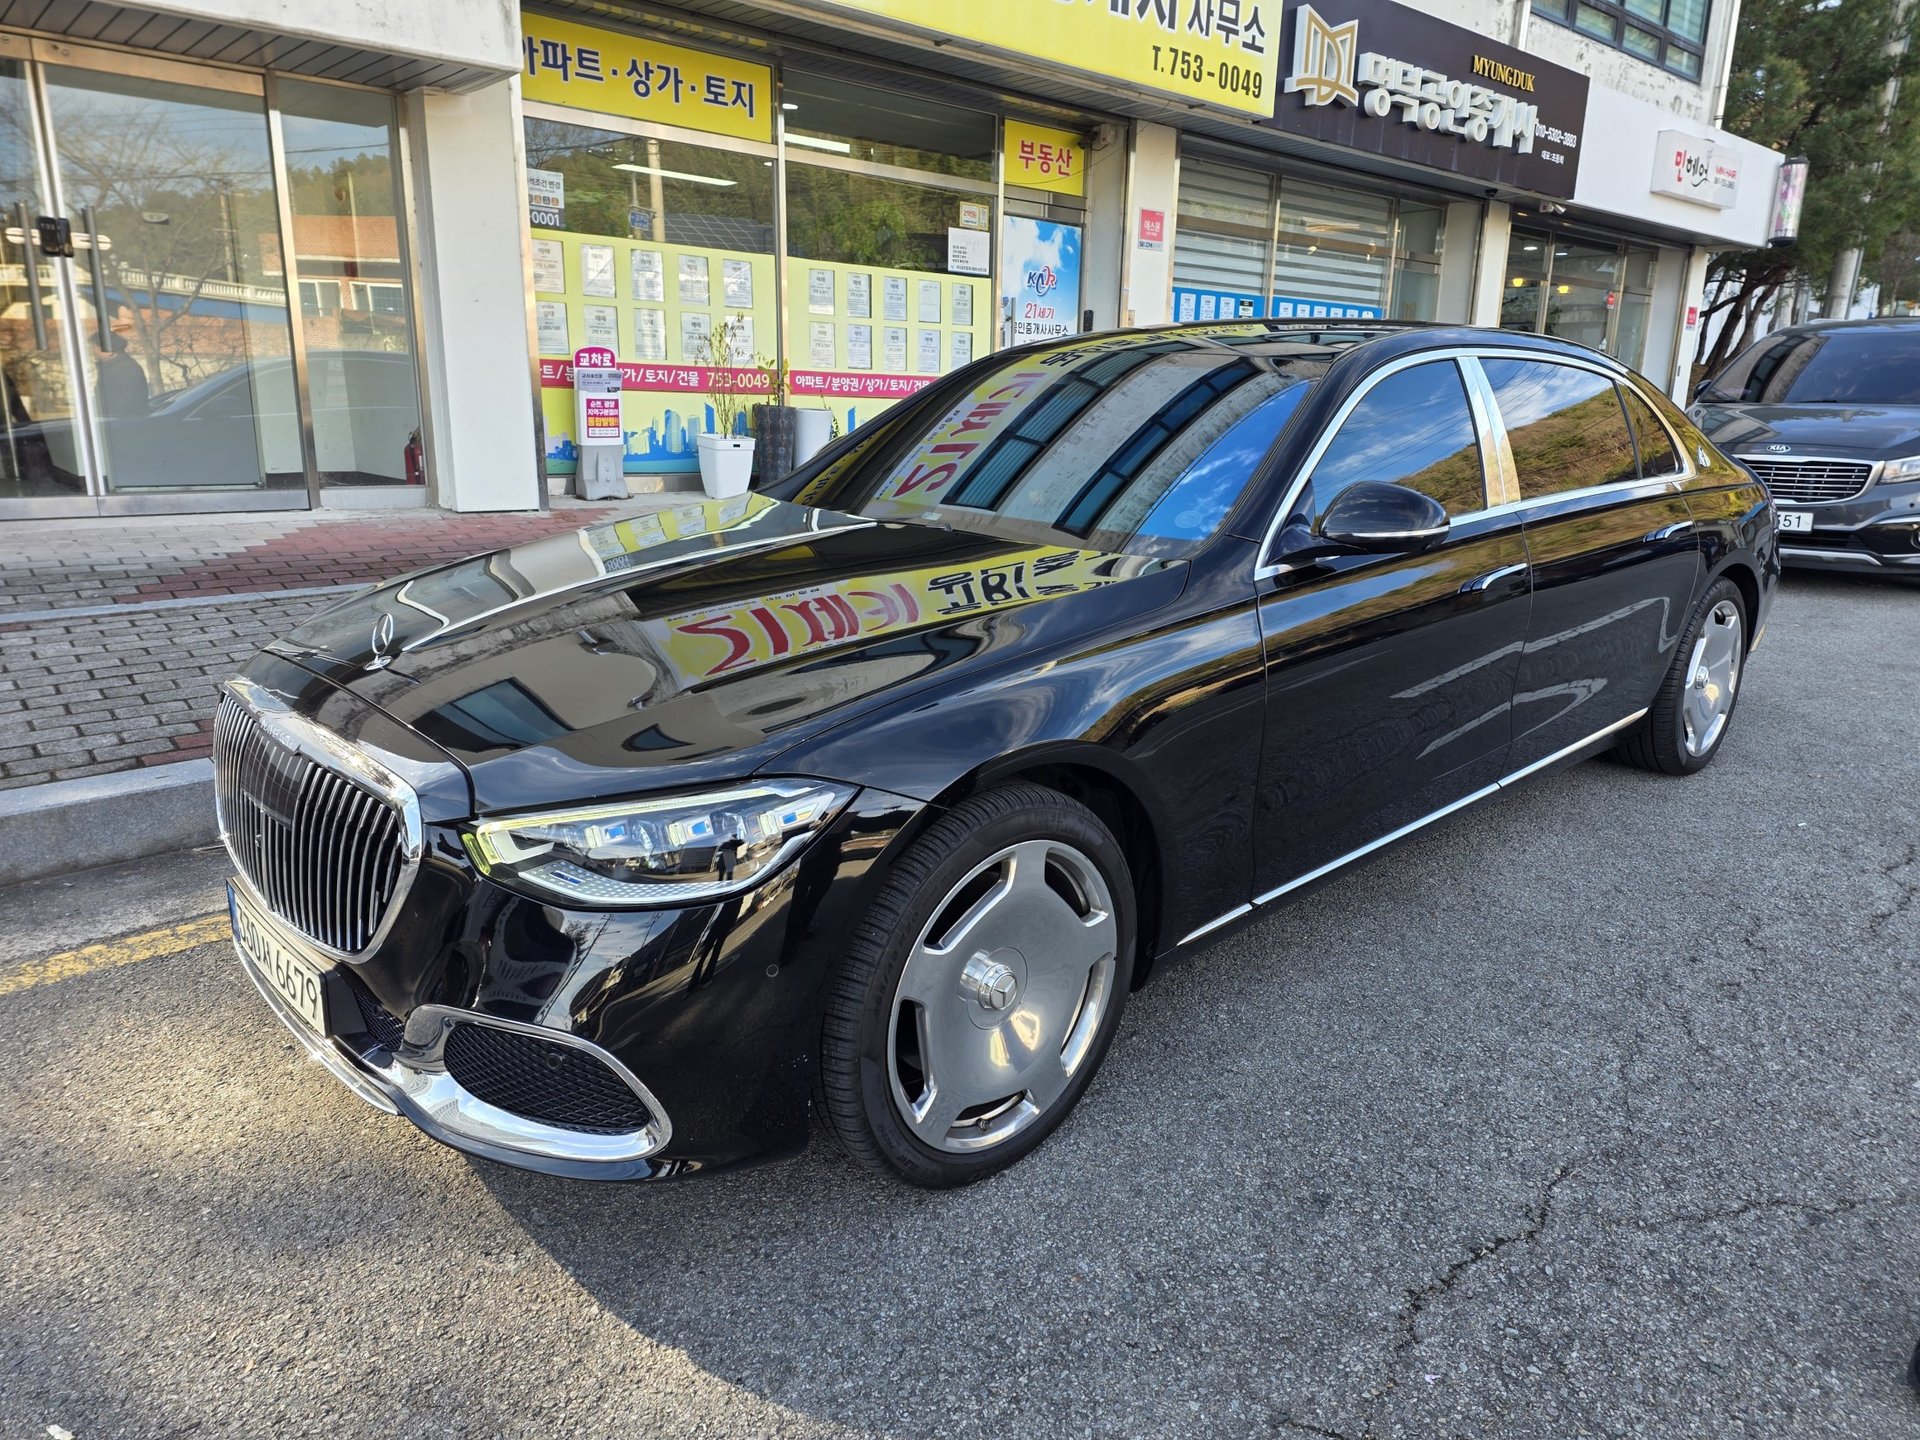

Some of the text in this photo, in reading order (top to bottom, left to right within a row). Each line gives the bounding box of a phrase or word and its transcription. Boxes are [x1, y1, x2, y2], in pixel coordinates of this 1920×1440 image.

[1187, 0, 1266, 54] 사무소
[1152, 45, 1263, 99] T.753-0049
[1472, 54, 1536, 92] MYUNGDUK
[1357, 51, 1538, 154] 명덕공인중개사
[1018, 139, 1073, 177] 부동산
[1024, 302, 1055, 320] 21세기
[579, 352, 612, 367] 교차로
[1768, 444, 1788, 452] KIA
[276, 948, 318, 1020] 6679
